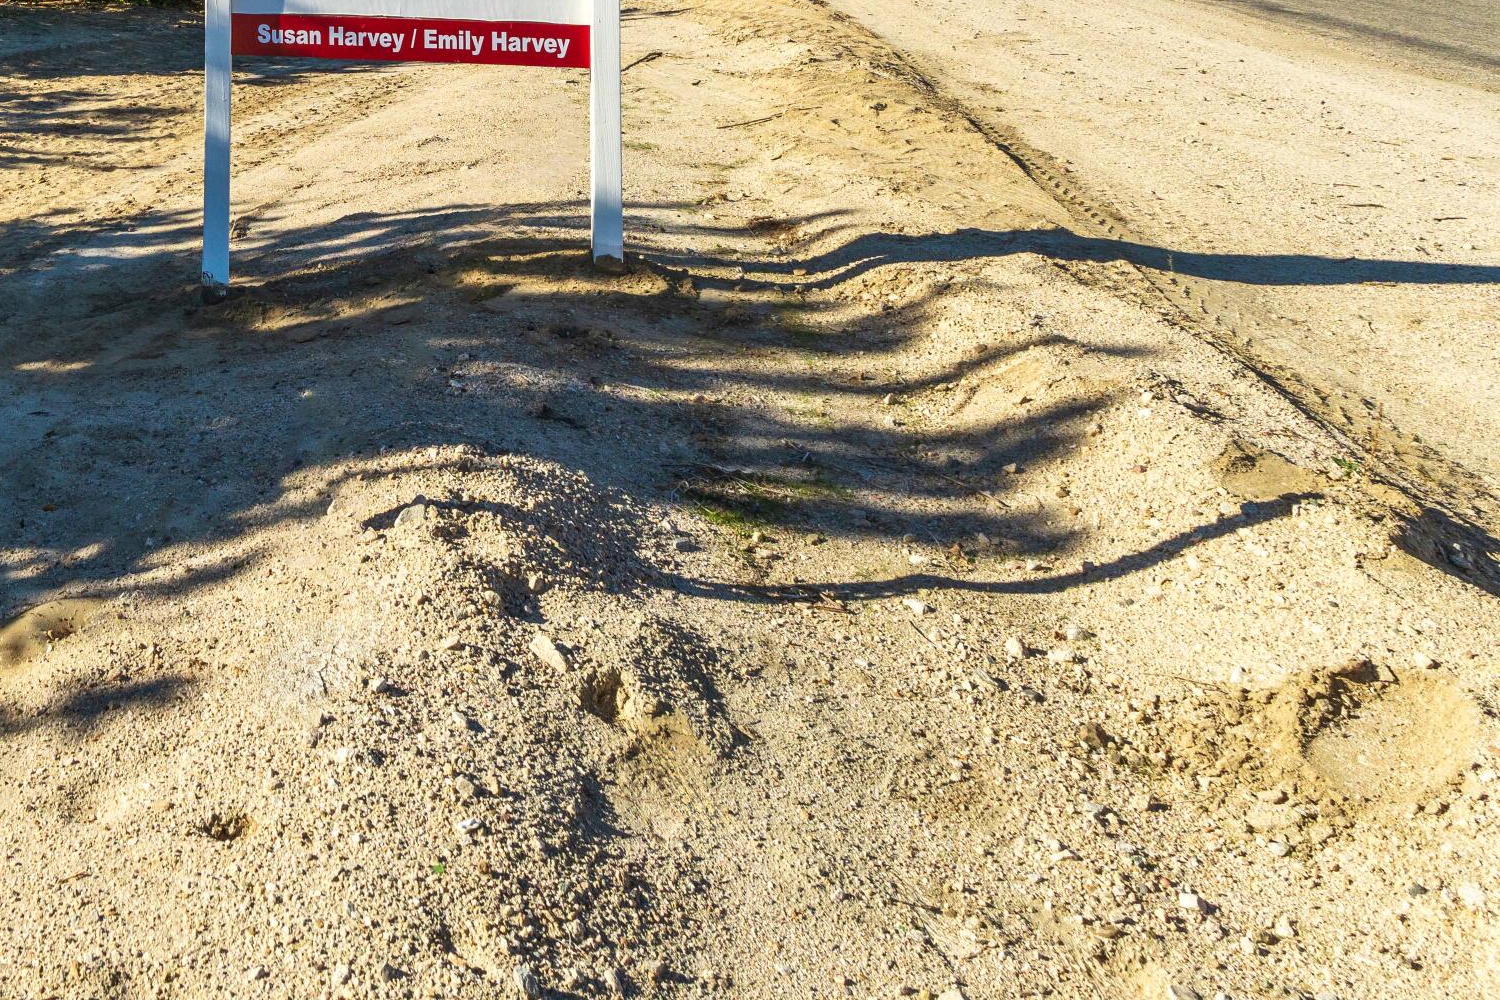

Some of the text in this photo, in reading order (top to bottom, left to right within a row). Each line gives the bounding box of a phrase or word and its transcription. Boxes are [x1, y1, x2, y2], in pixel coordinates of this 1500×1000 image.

[257, 23, 570, 58] Susan Harvey / Emily Harvey
